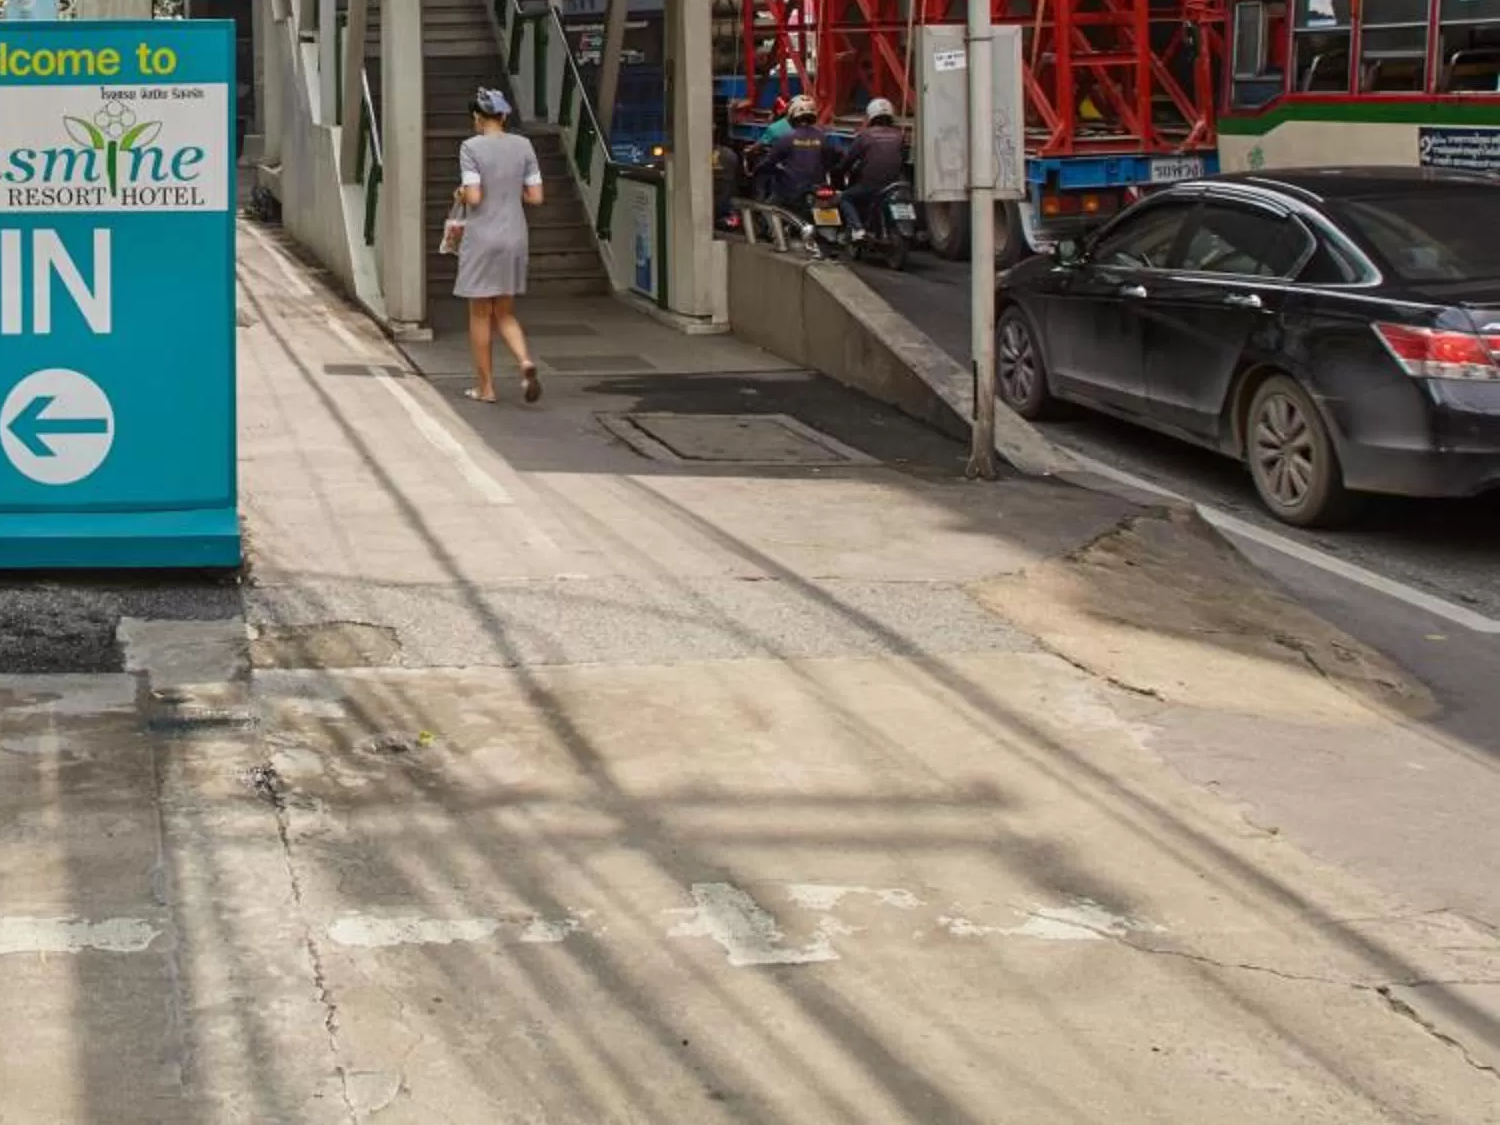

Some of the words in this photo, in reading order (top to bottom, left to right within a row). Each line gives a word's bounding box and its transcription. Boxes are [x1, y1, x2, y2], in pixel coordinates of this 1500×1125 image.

[136, 43, 177, 74] to
[8, 187, 107, 206] RESORT
[121, 187, 205, 206] HOTEL
[0, 228, 112, 335] IN
